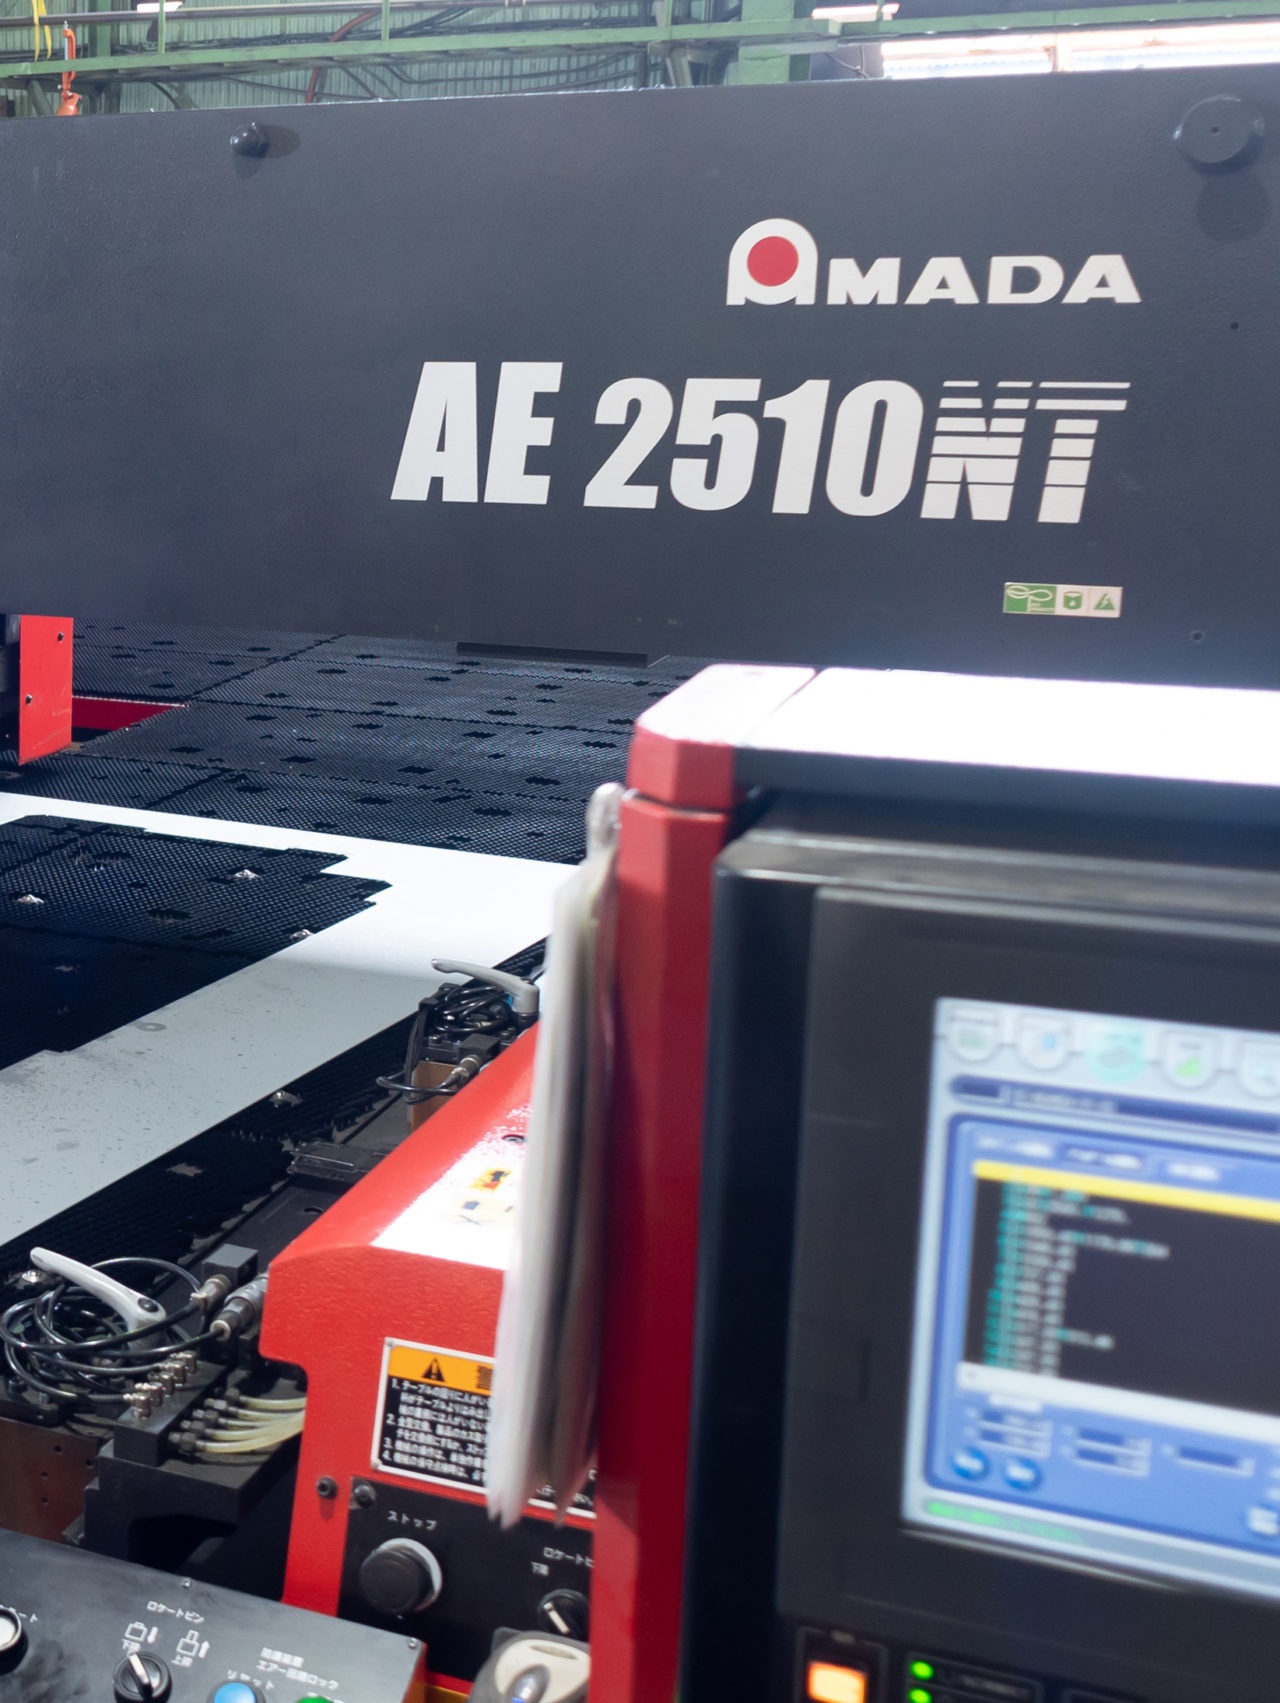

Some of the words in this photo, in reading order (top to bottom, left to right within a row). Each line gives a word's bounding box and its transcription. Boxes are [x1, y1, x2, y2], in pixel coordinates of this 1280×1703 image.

[726, 218, 1141, 306] AMADA
[391, 362, 564, 505] AE
[387, 1510, 437, 1530] ストップ
[147, 1600, 204, 1623] ロケートピン
